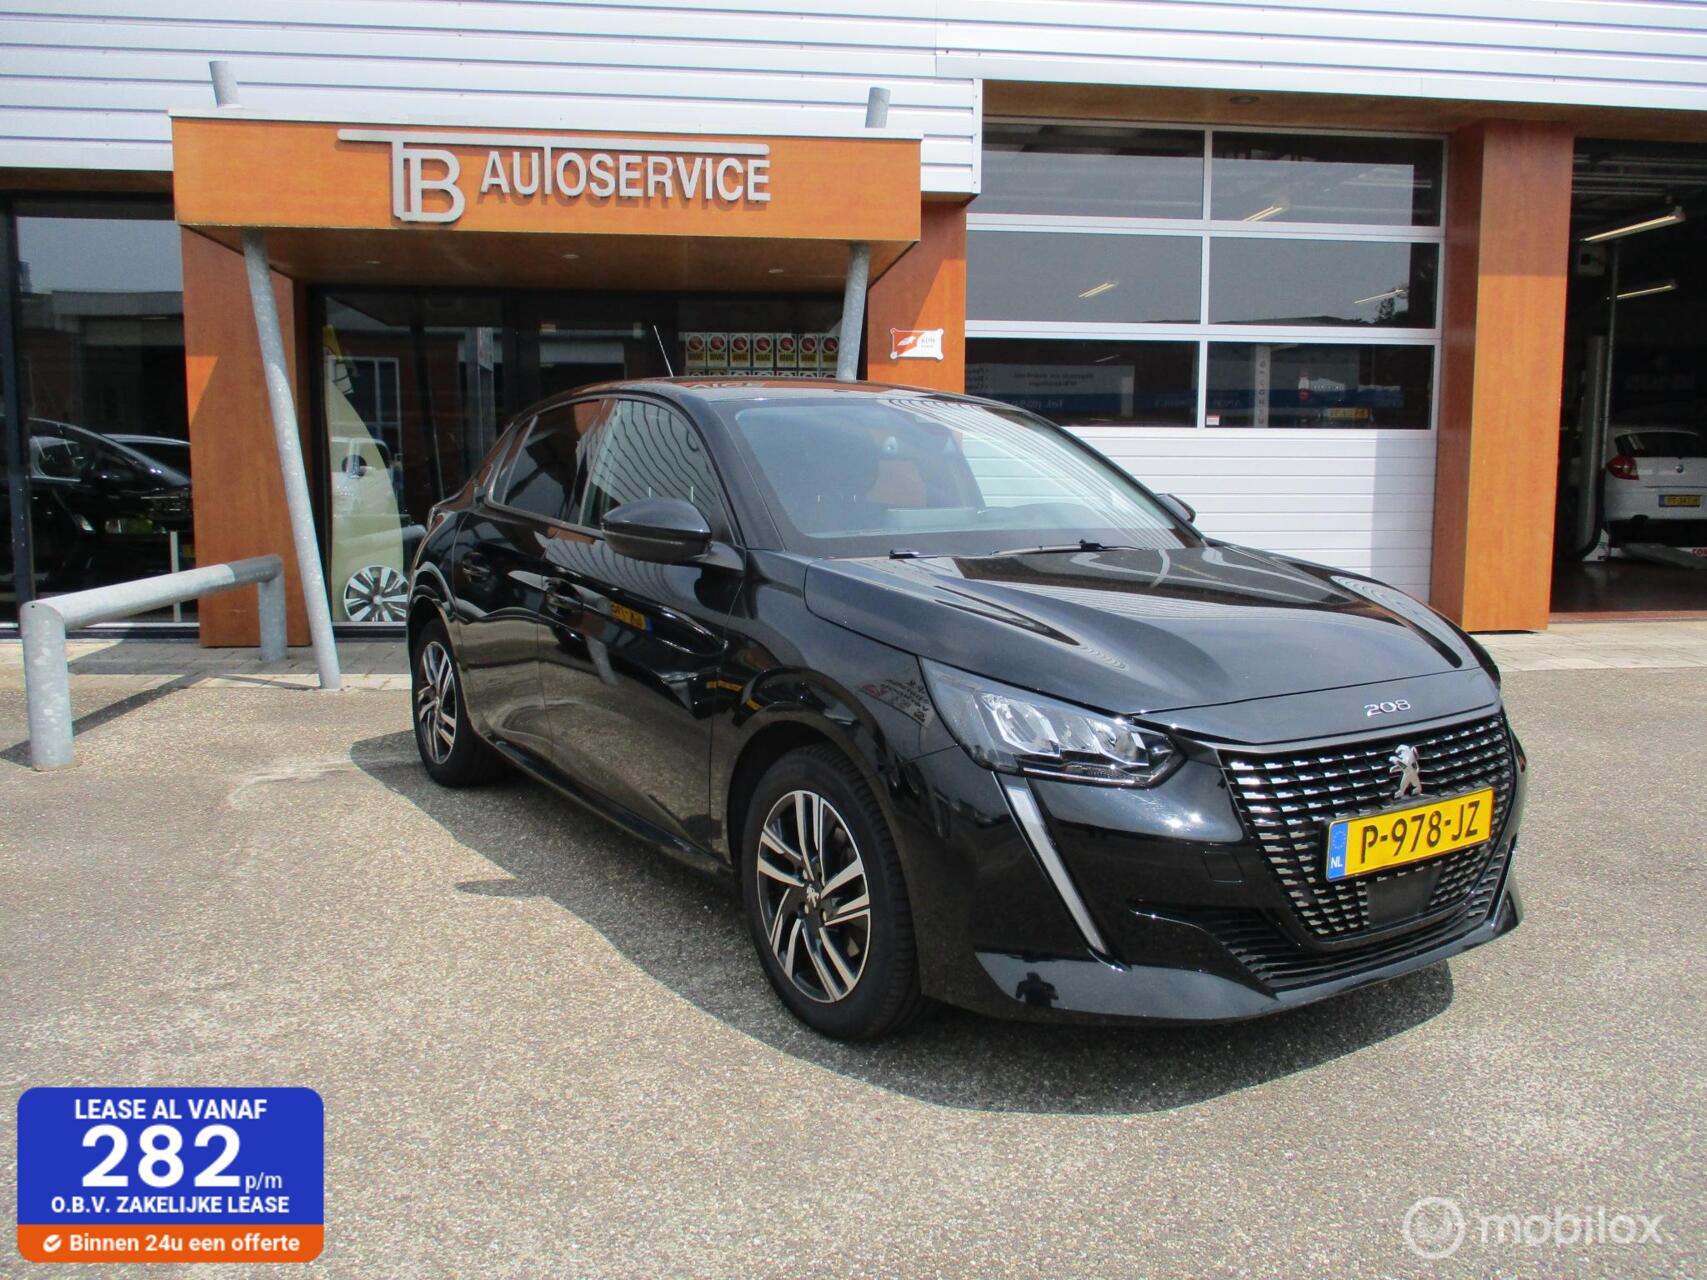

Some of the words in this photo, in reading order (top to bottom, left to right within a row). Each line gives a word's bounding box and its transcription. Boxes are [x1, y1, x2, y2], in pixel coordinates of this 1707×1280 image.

[338, 128, 466, 223] TB
[480, 138, 771, 202] AUTOSERVICE
[1363, 699, 1411, 717] 208
[1330, 857, 1343, 868] NL
[1360, 800, 1480, 864] P-978-JZ
